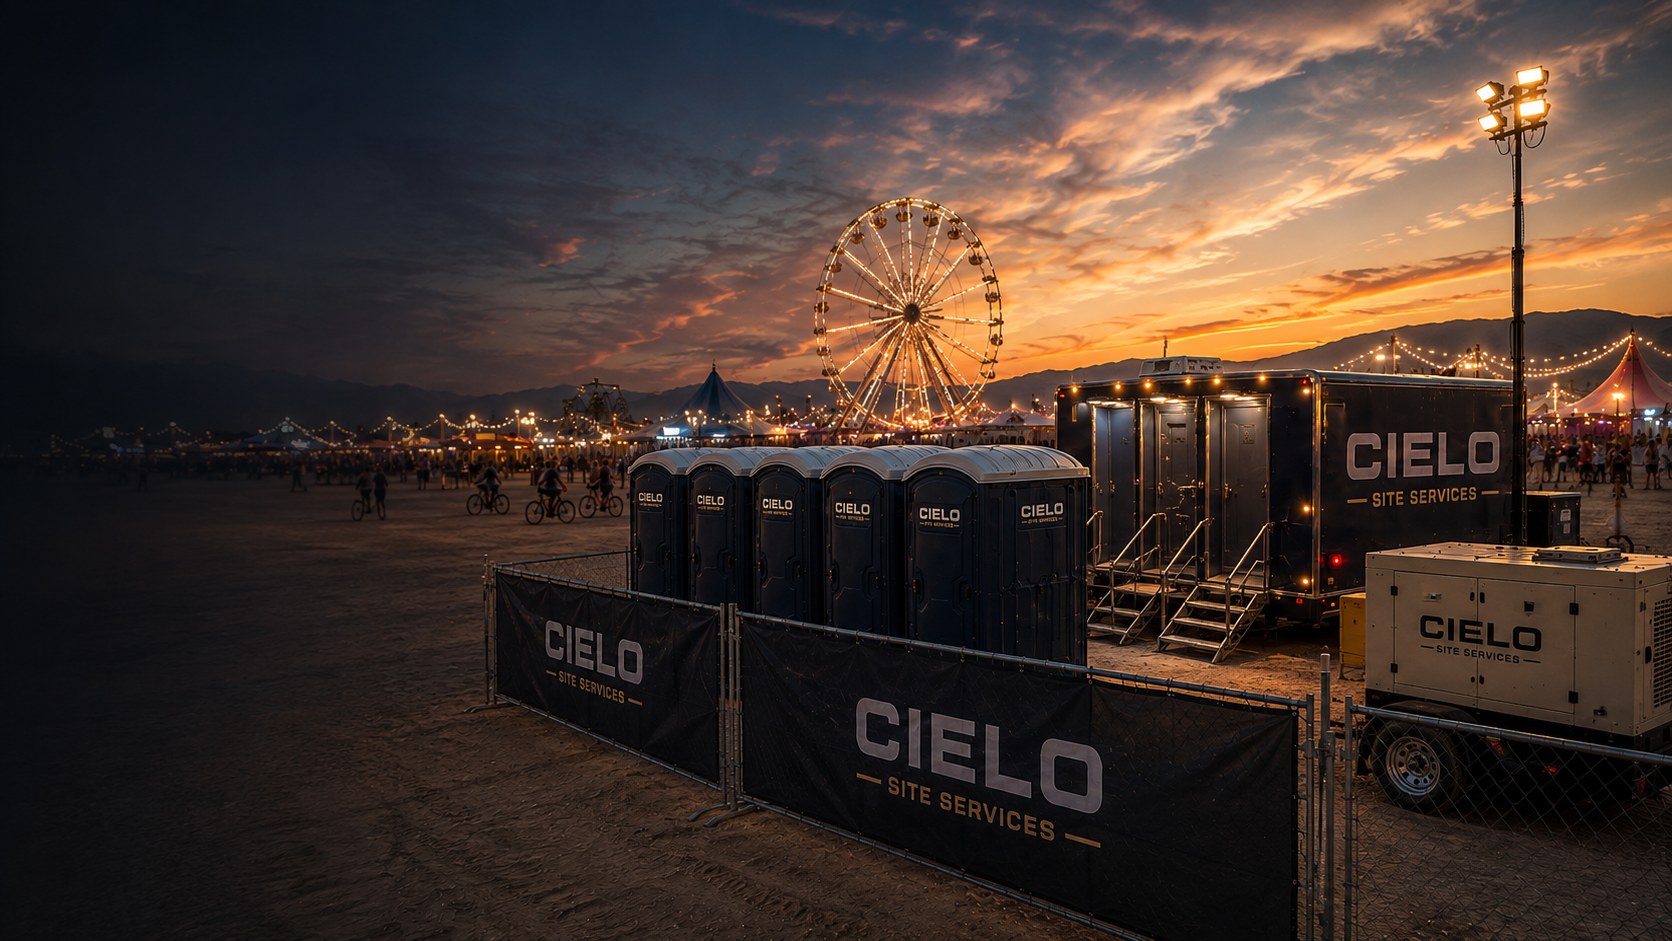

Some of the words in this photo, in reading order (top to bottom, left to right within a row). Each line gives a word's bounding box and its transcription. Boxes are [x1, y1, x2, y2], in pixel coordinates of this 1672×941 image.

[1346, 431, 1500, 481] CIELO
[638, 492, 663, 503] CIELO
[696, 495, 725, 506] CIELO
[762, 498, 793, 510] CIELO
[1372, 491, 1404, 508] SITE
[1409, 486, 1477, 505] SERVICES
[835, 502, 871, 515] CIELO
[919, 507, 961, 522] CIELO
[1021, 502, 1064, 518] CIELO
[1420, 615, 1542, 652] CIELO
[545, 620, 643, 685] CIELO
[1436, 645, 1460, 656] SITE
[1463, 648, 1520, 664] SERVICES
[558, 670, 577, 688] SITE
[579, 677, 625, 704] SERVICES
[855, 697, 1103, 814] CIELO
[887, 776, 932, 806] SITE
[939, 790, 1056, 842] SERVICES
